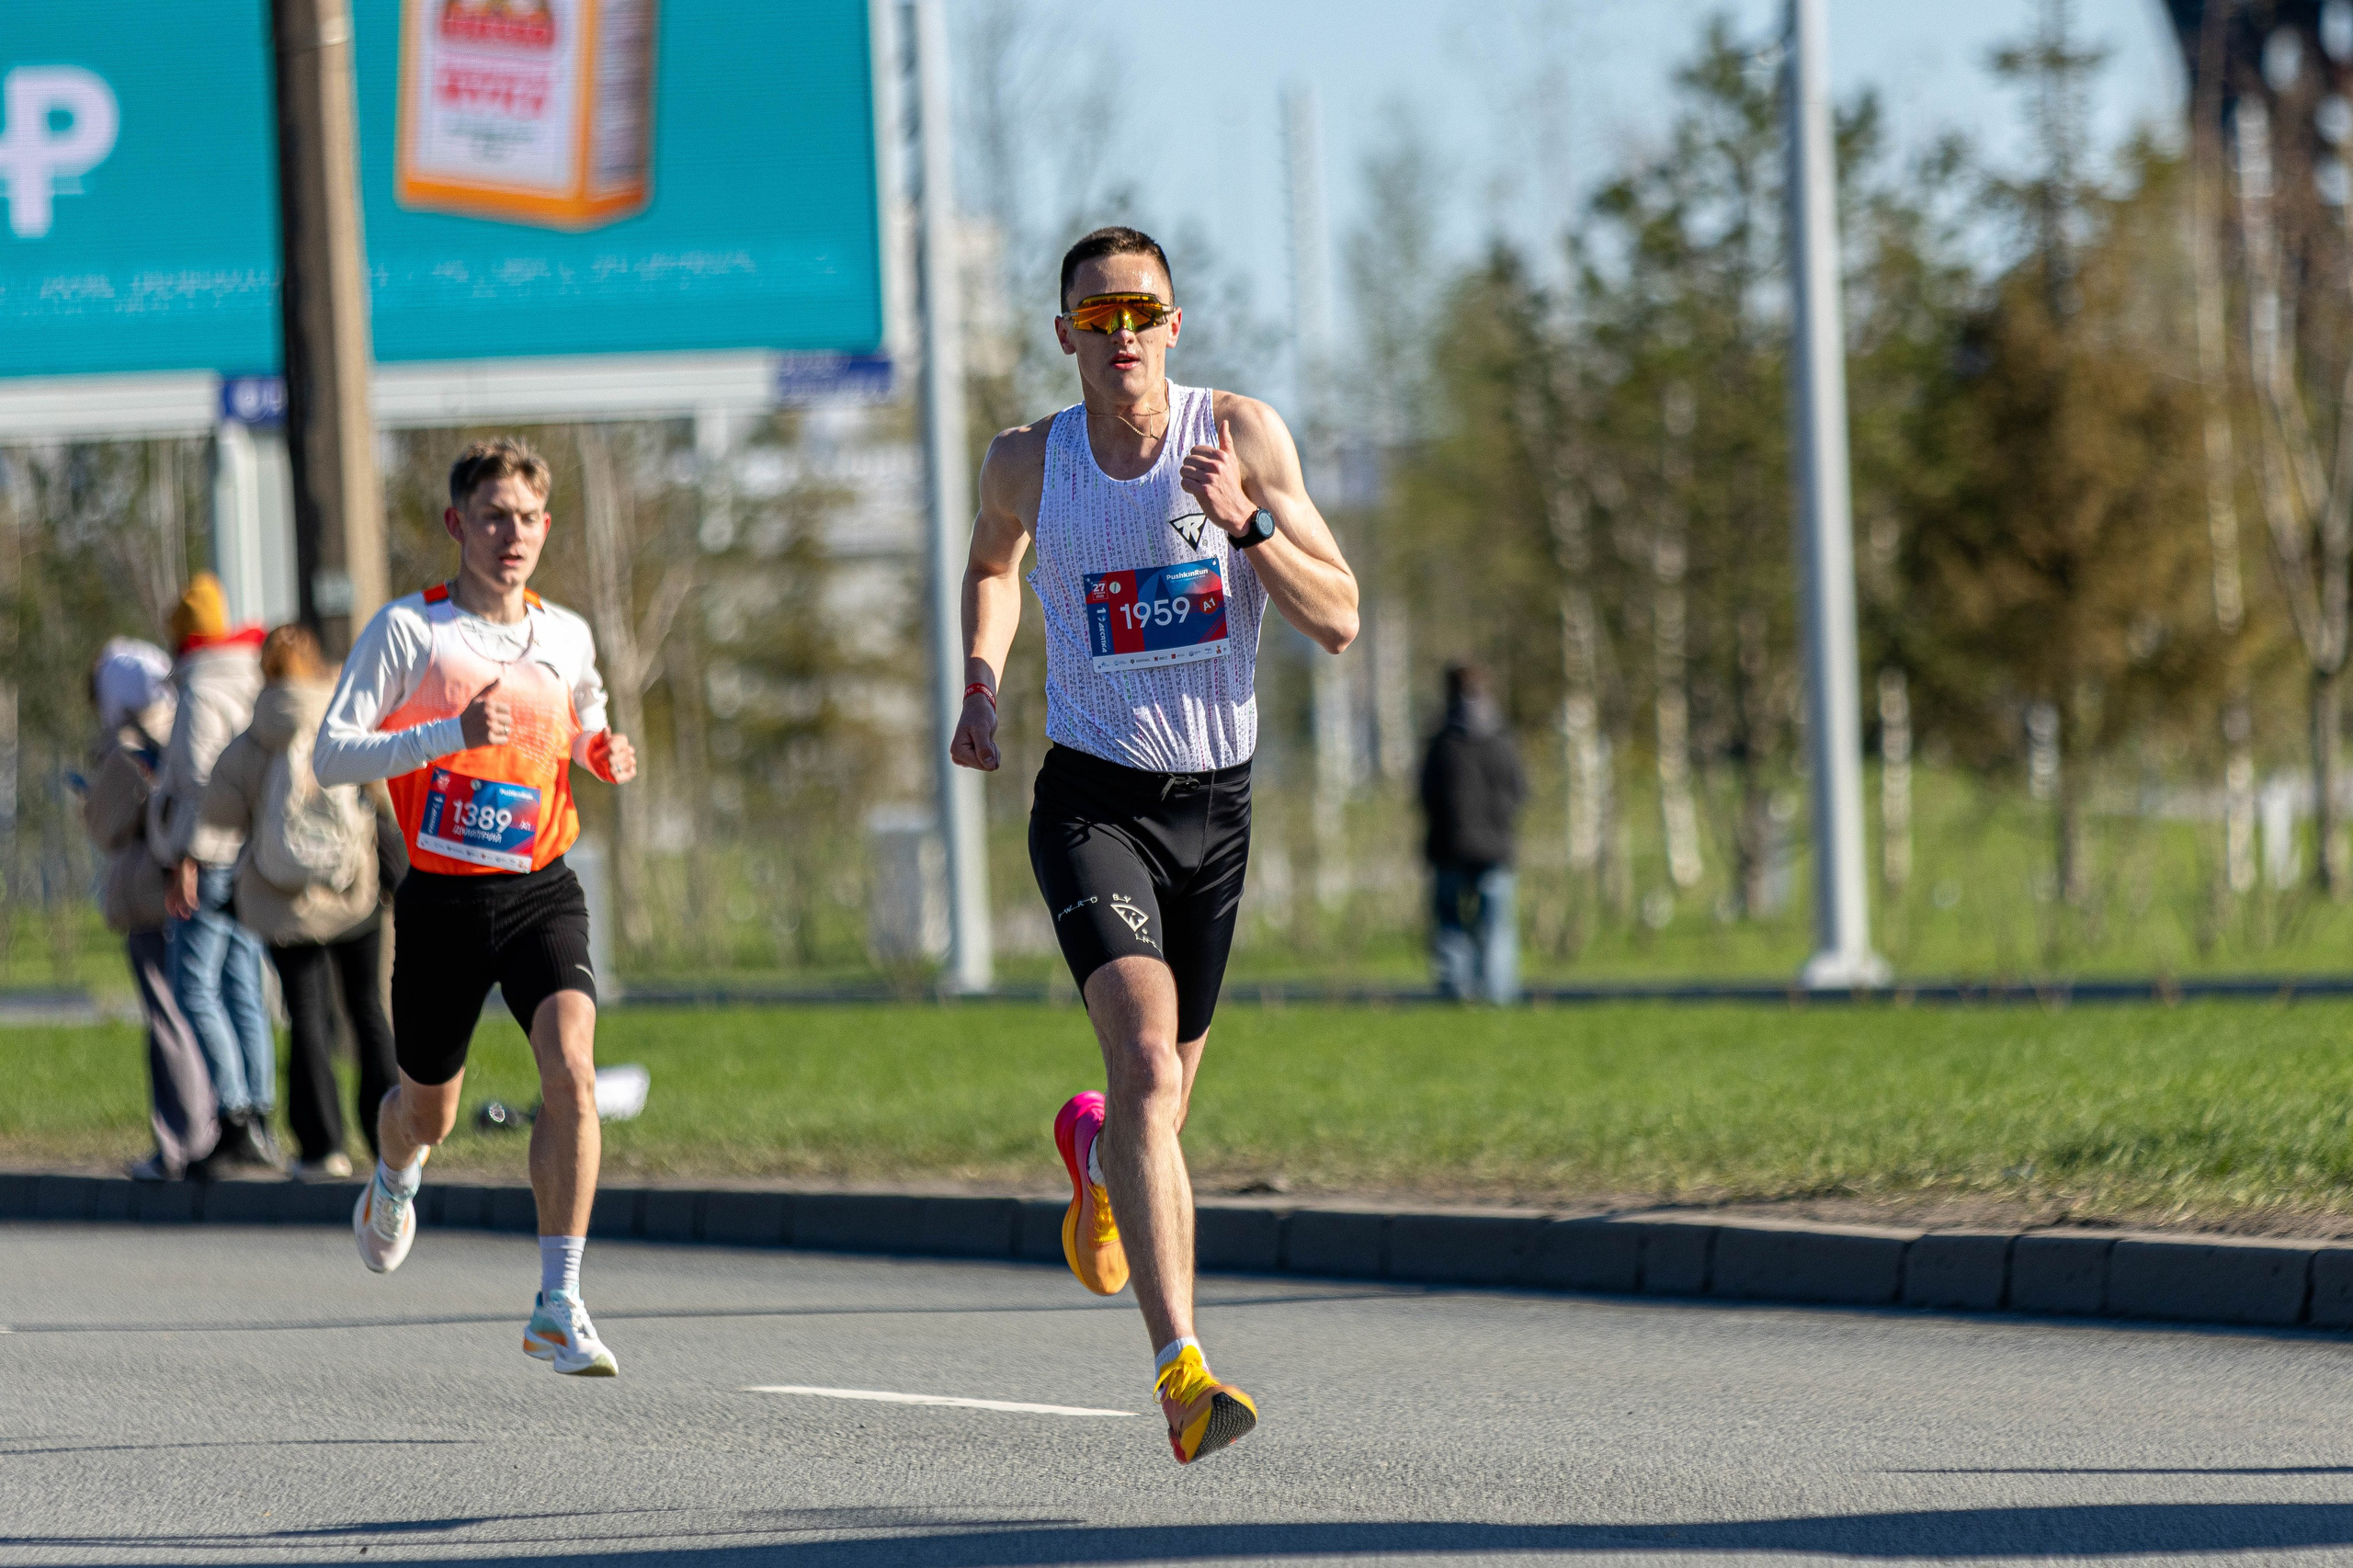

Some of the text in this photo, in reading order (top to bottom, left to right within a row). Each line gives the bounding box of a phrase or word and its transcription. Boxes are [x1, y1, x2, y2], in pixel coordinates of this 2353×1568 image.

[1166, 568, 1209, 581] PushkinRun
[1093, 583, 1106, 593] 27
[1201, 597, 1216, 612] A1
[1120, 597, 1191, 630] 1959
[452, 799, 513, 834] 1389
